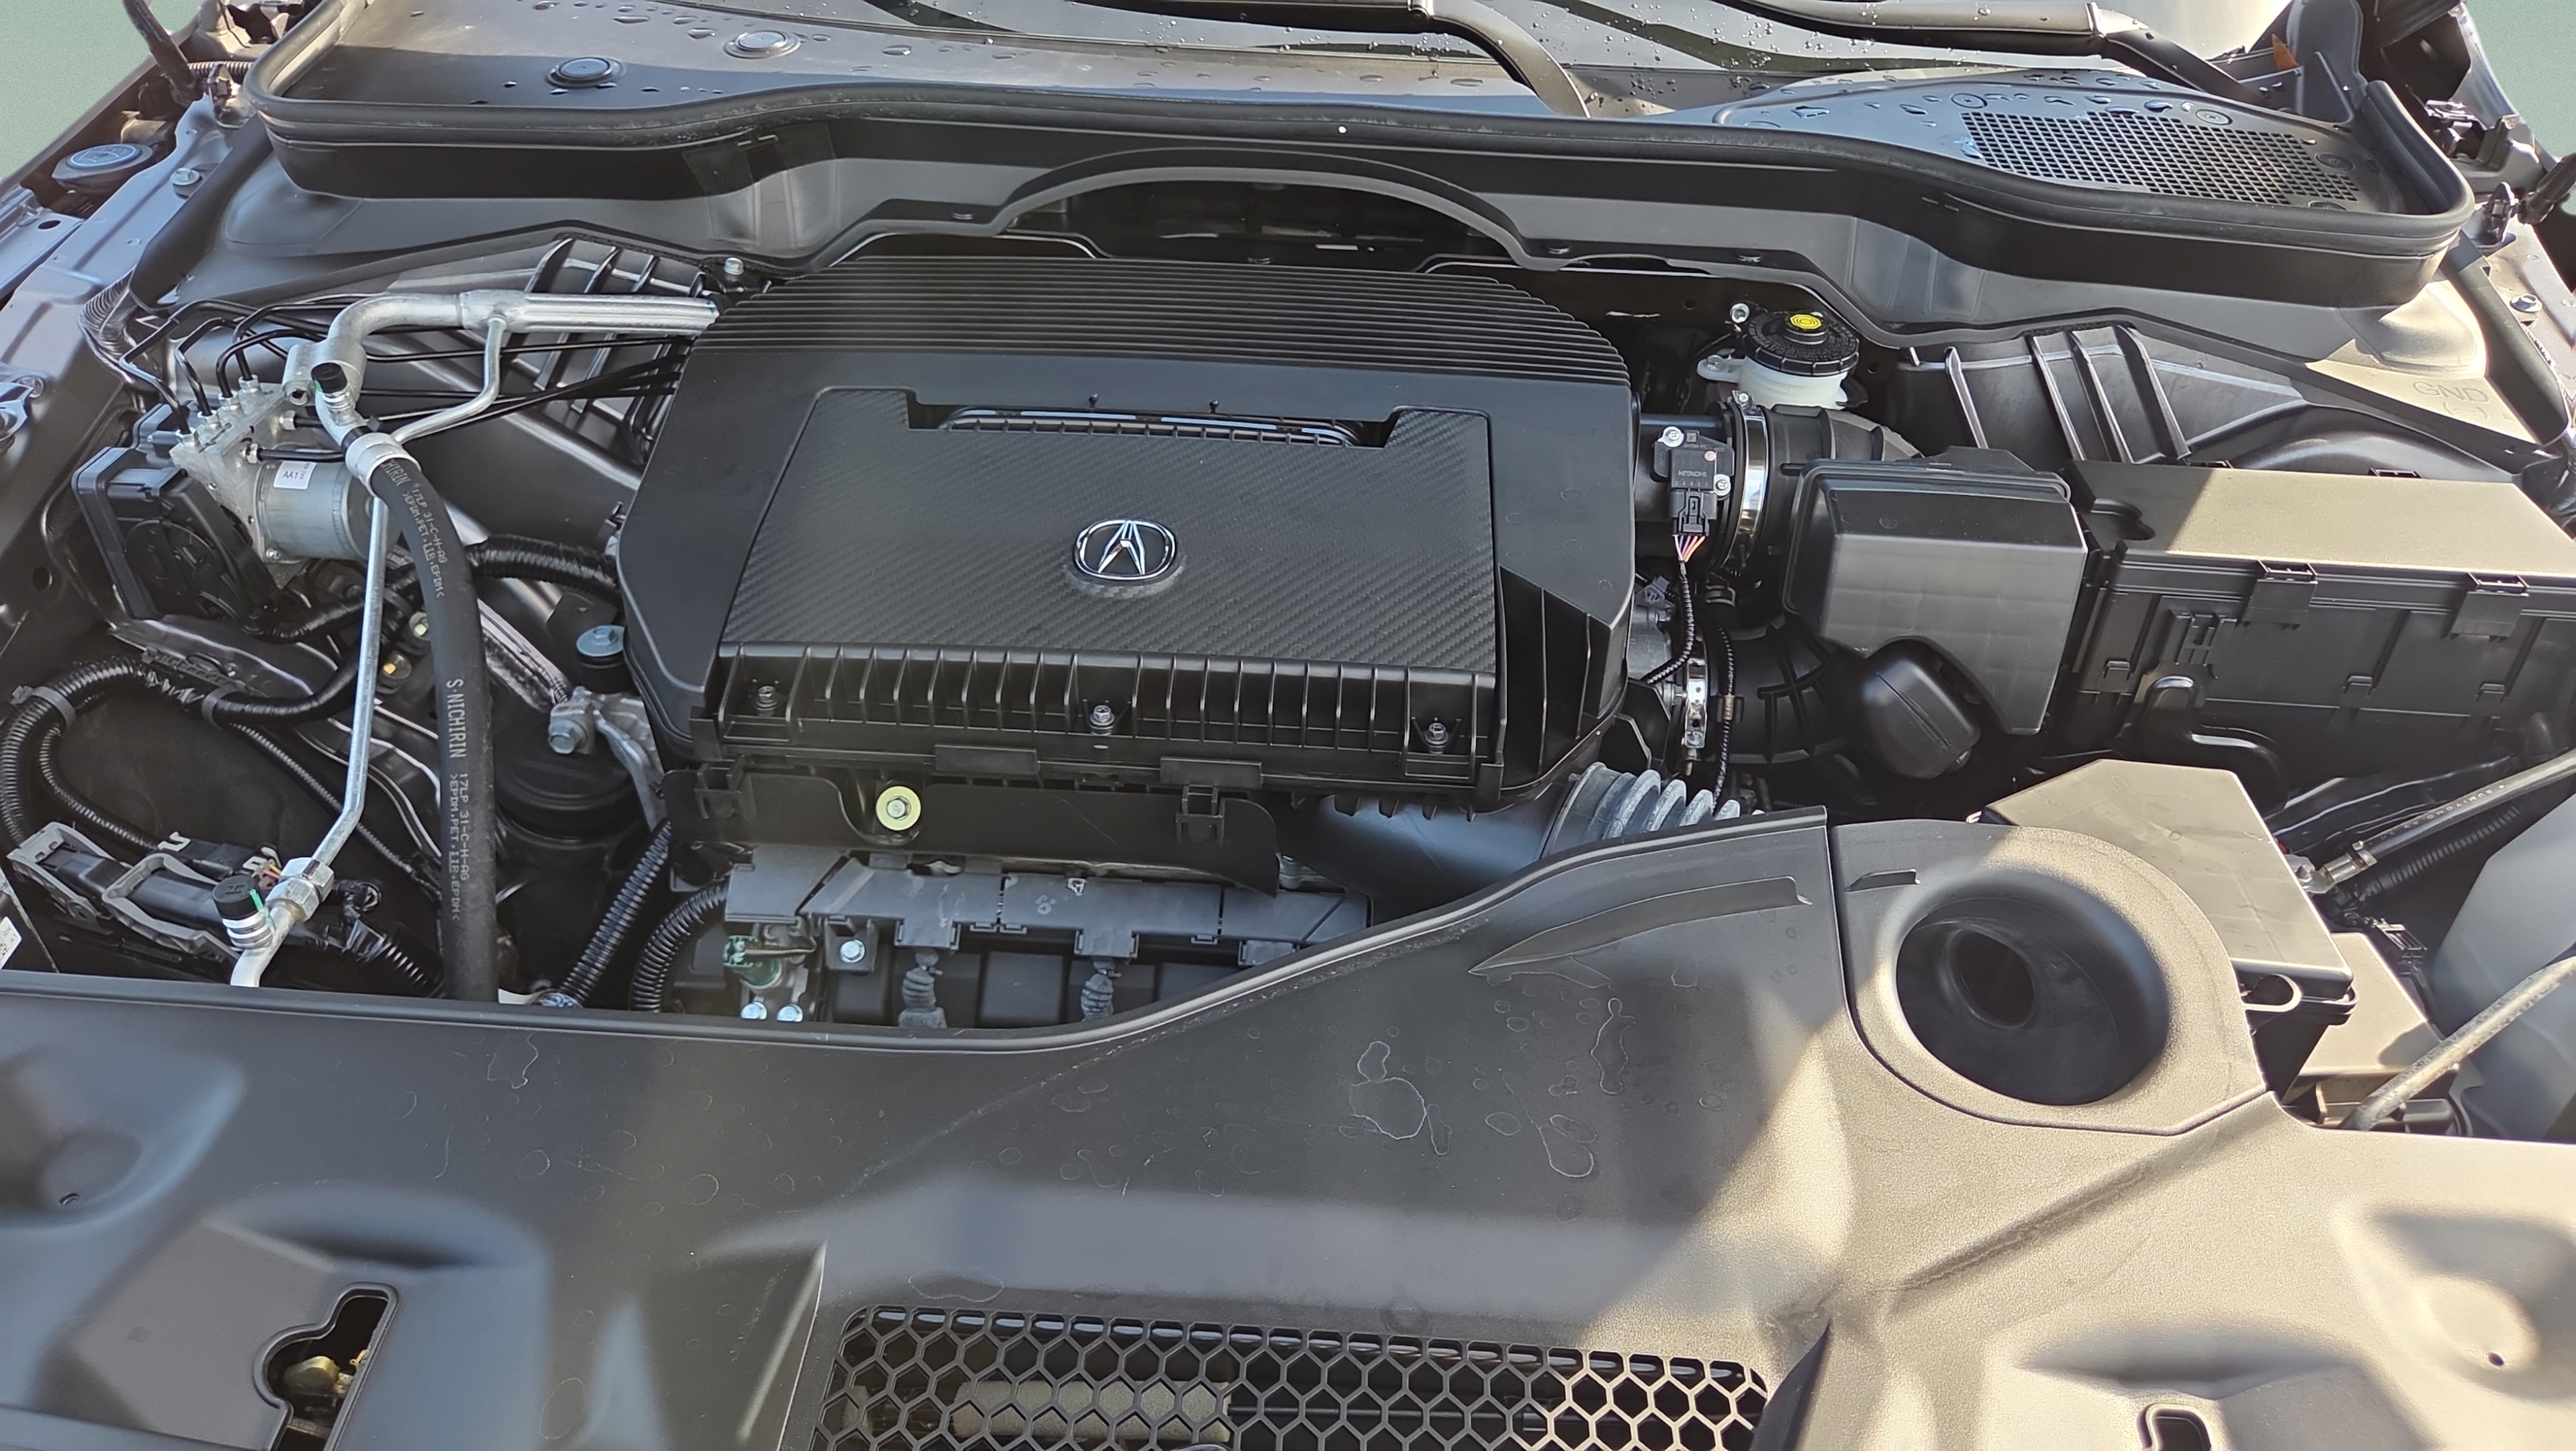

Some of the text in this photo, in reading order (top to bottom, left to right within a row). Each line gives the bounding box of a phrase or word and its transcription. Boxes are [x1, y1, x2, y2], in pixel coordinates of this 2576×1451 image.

[2413, 381, 2489, 403] GND
[283, 470, 299, 480] AA1
[459, 773, 470, 881] 17LP 31-C-H-AG
